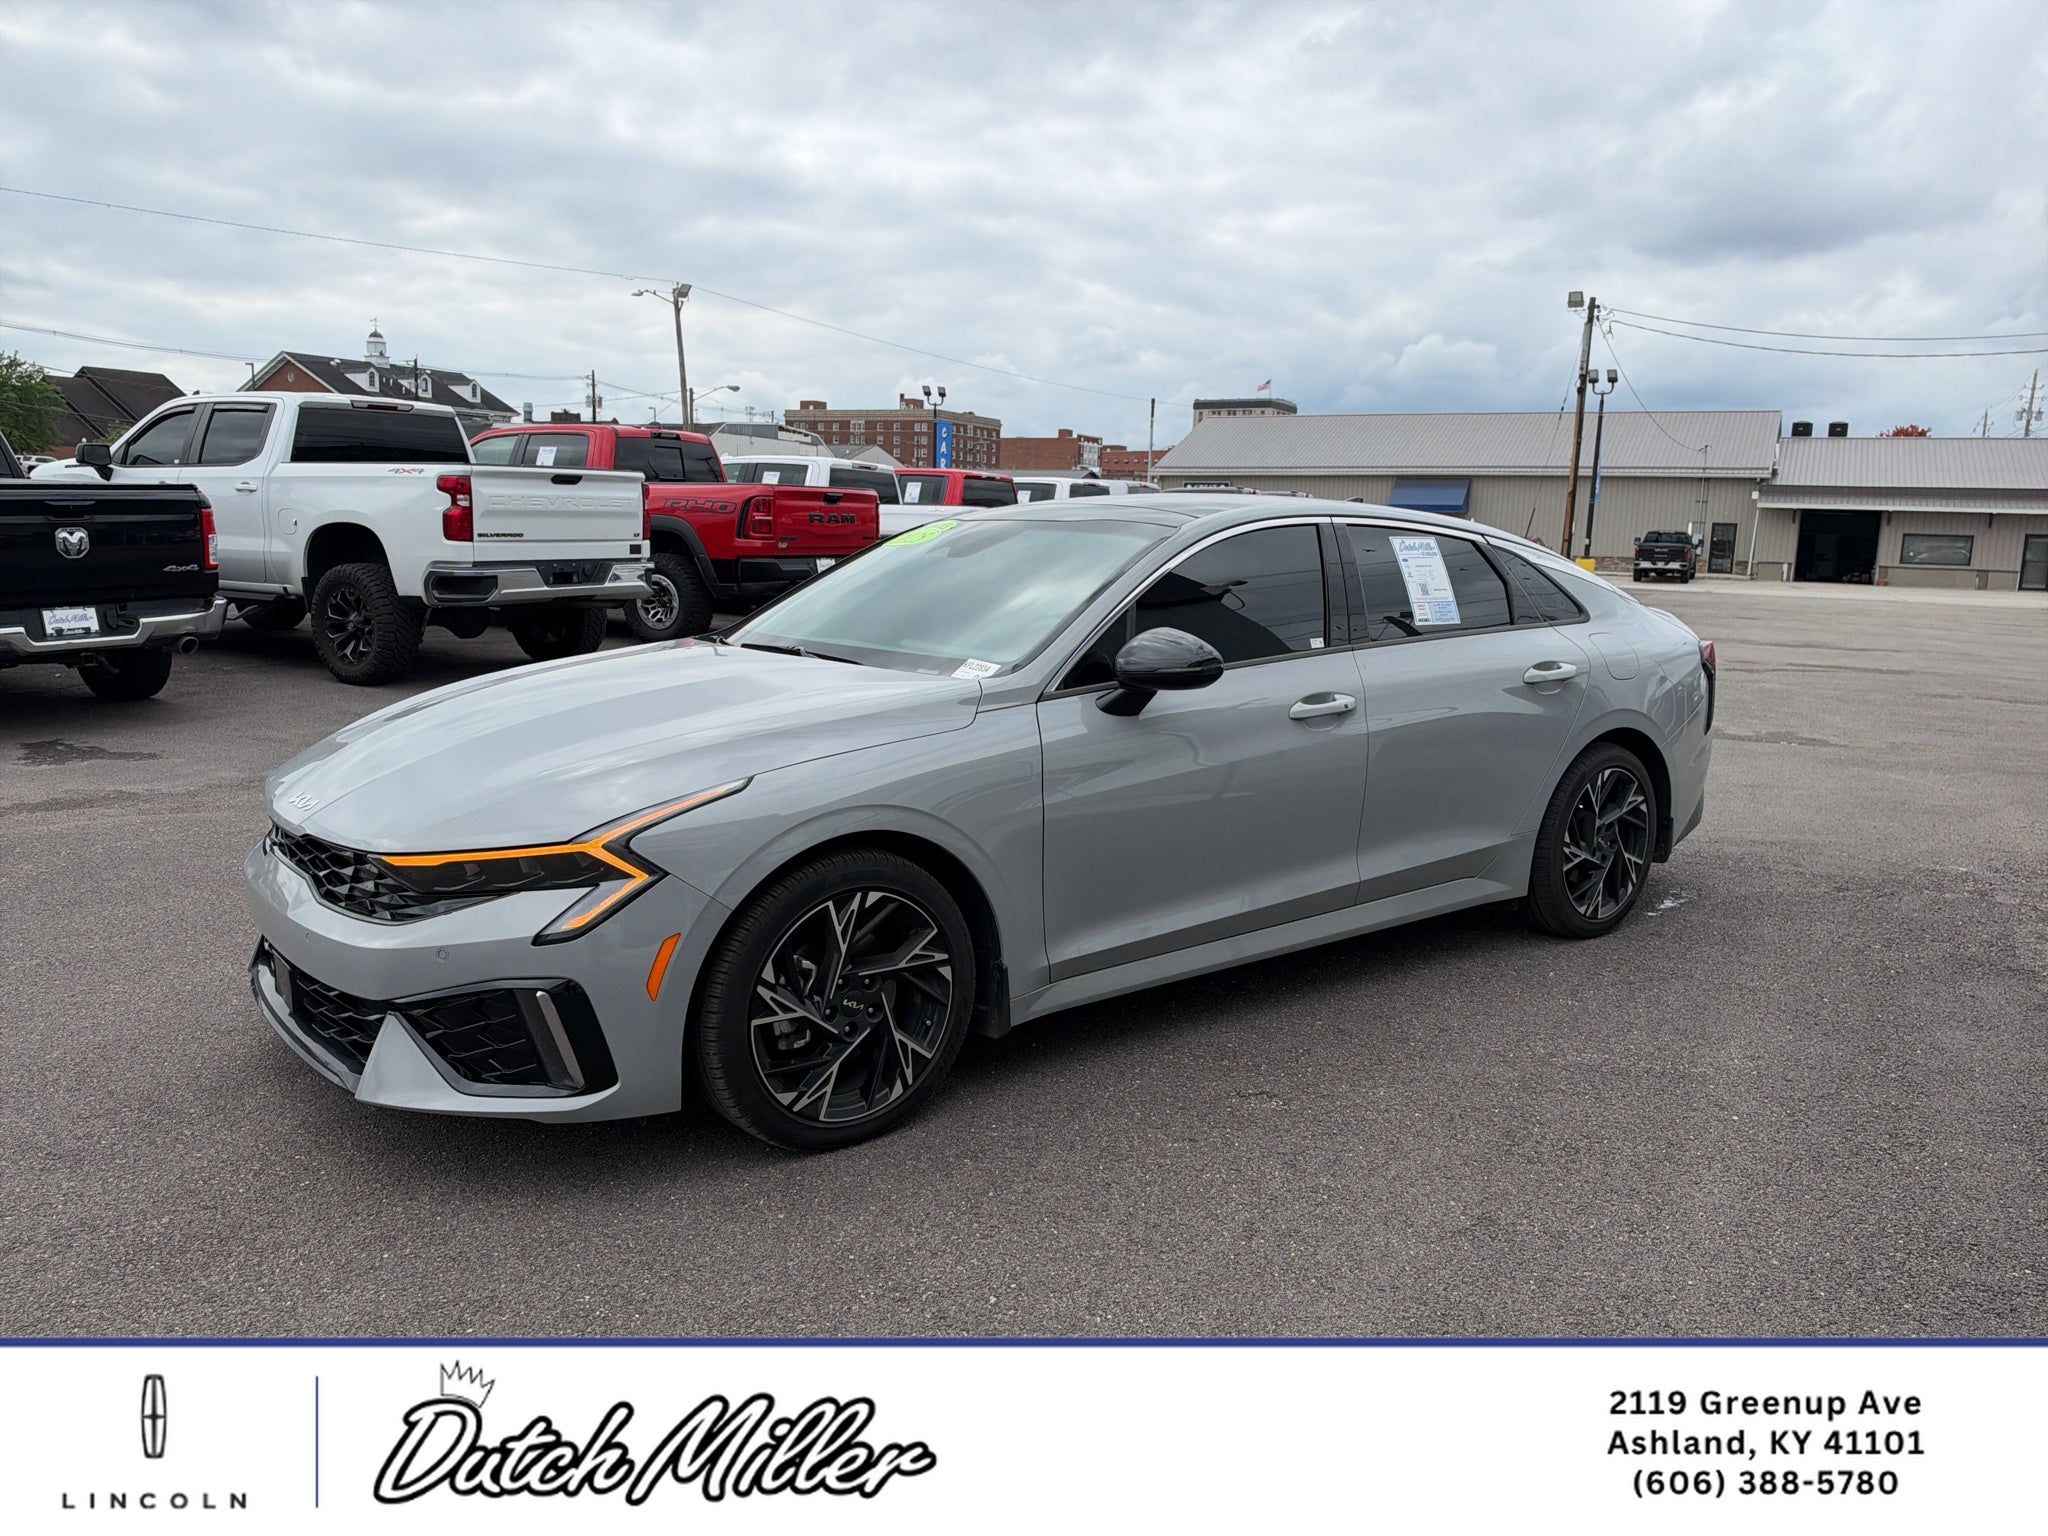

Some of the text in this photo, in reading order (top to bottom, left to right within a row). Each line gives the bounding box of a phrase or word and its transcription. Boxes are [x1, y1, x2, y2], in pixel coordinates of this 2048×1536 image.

[489, 495, 635, 510] CHEVROLET
[663, 497, 738, 515] RHO
[808, 512, 856, 525] RAM
